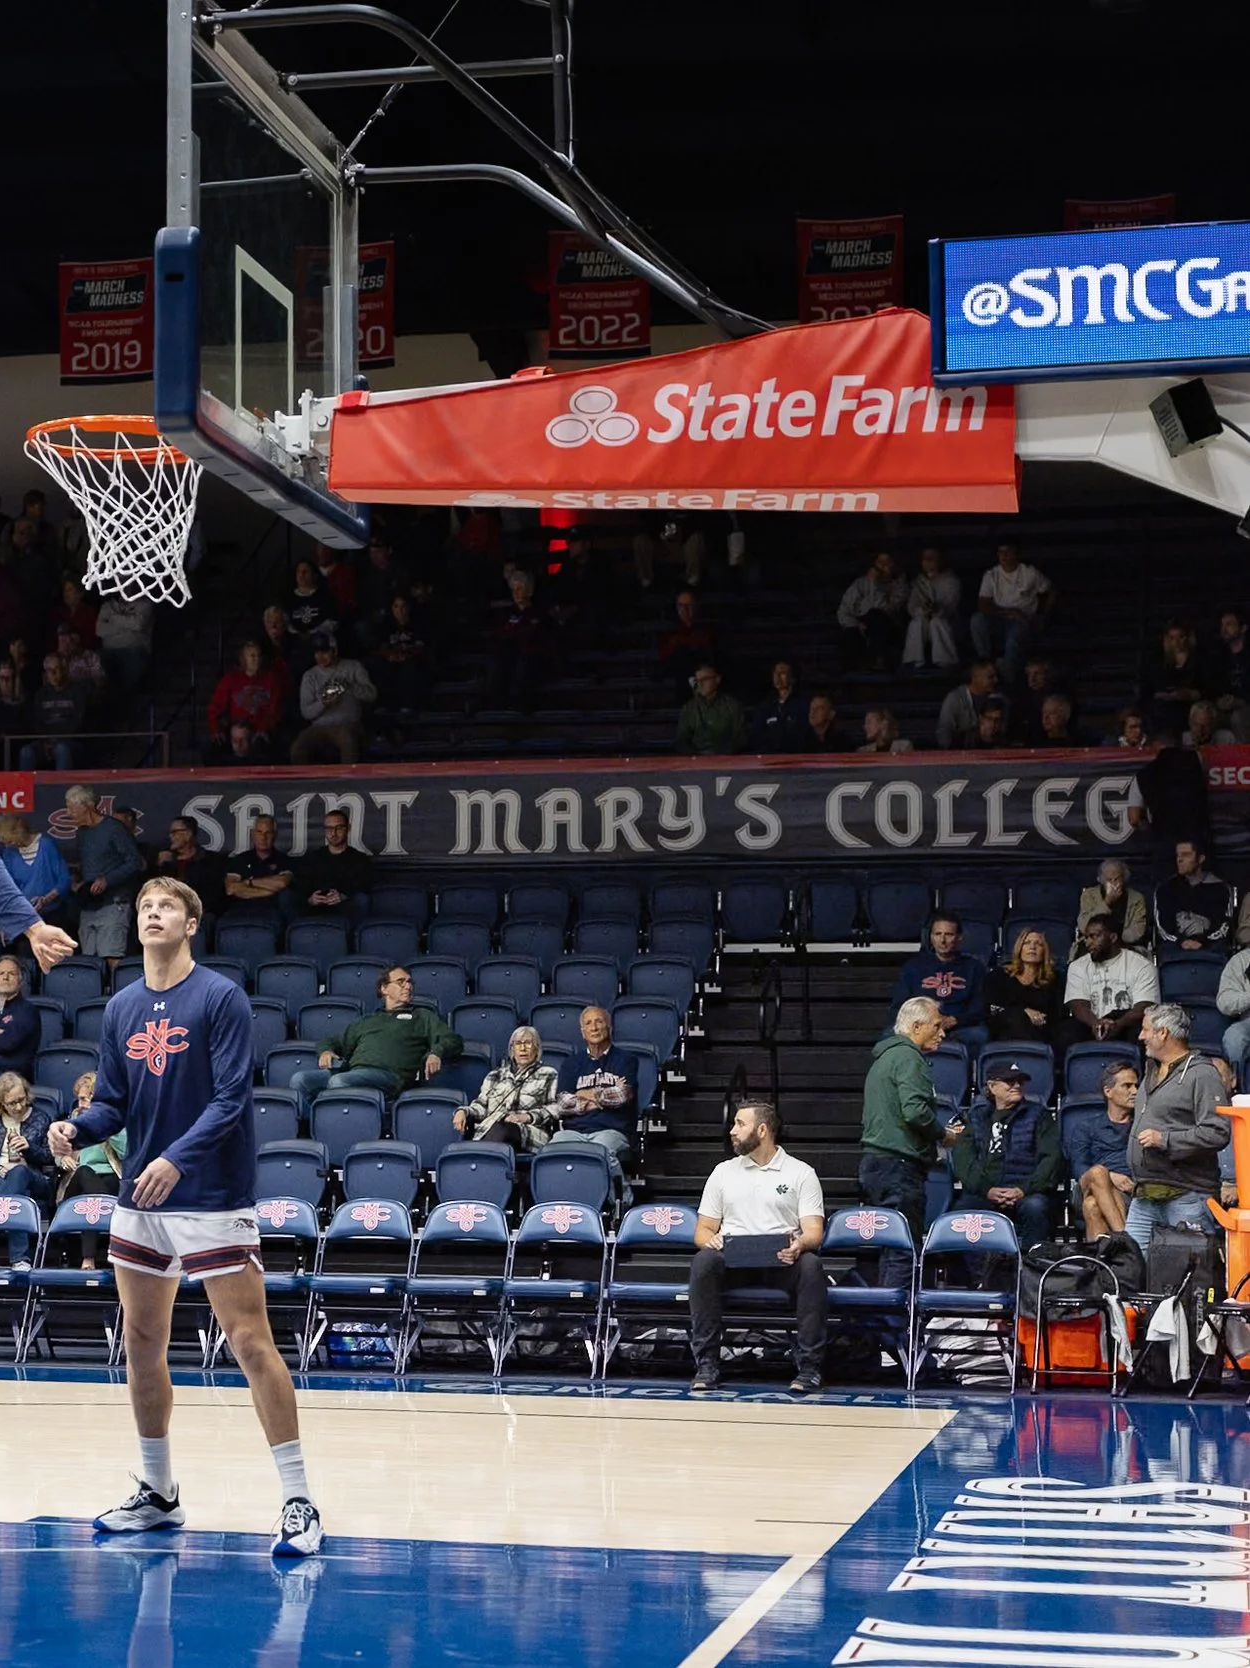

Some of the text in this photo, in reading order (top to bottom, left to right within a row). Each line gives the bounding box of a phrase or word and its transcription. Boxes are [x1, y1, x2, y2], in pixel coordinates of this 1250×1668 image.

[825, 240, 872, 254] MARCH
[830, 250, 893, 268] MADNESS
[581, 262, 632, 278] MADNES
[84, 279, 126, 294] MARCH
[88, 290, 145, 307] MADNESS
[558, 312, 641, 345] 2022
[71, 340, 142, 371] 2019
[180, 790, 420, 857] SAINT
[448, 776, 782, 854] MARY'S
[825, 776, 1138, 848] COLLEG
